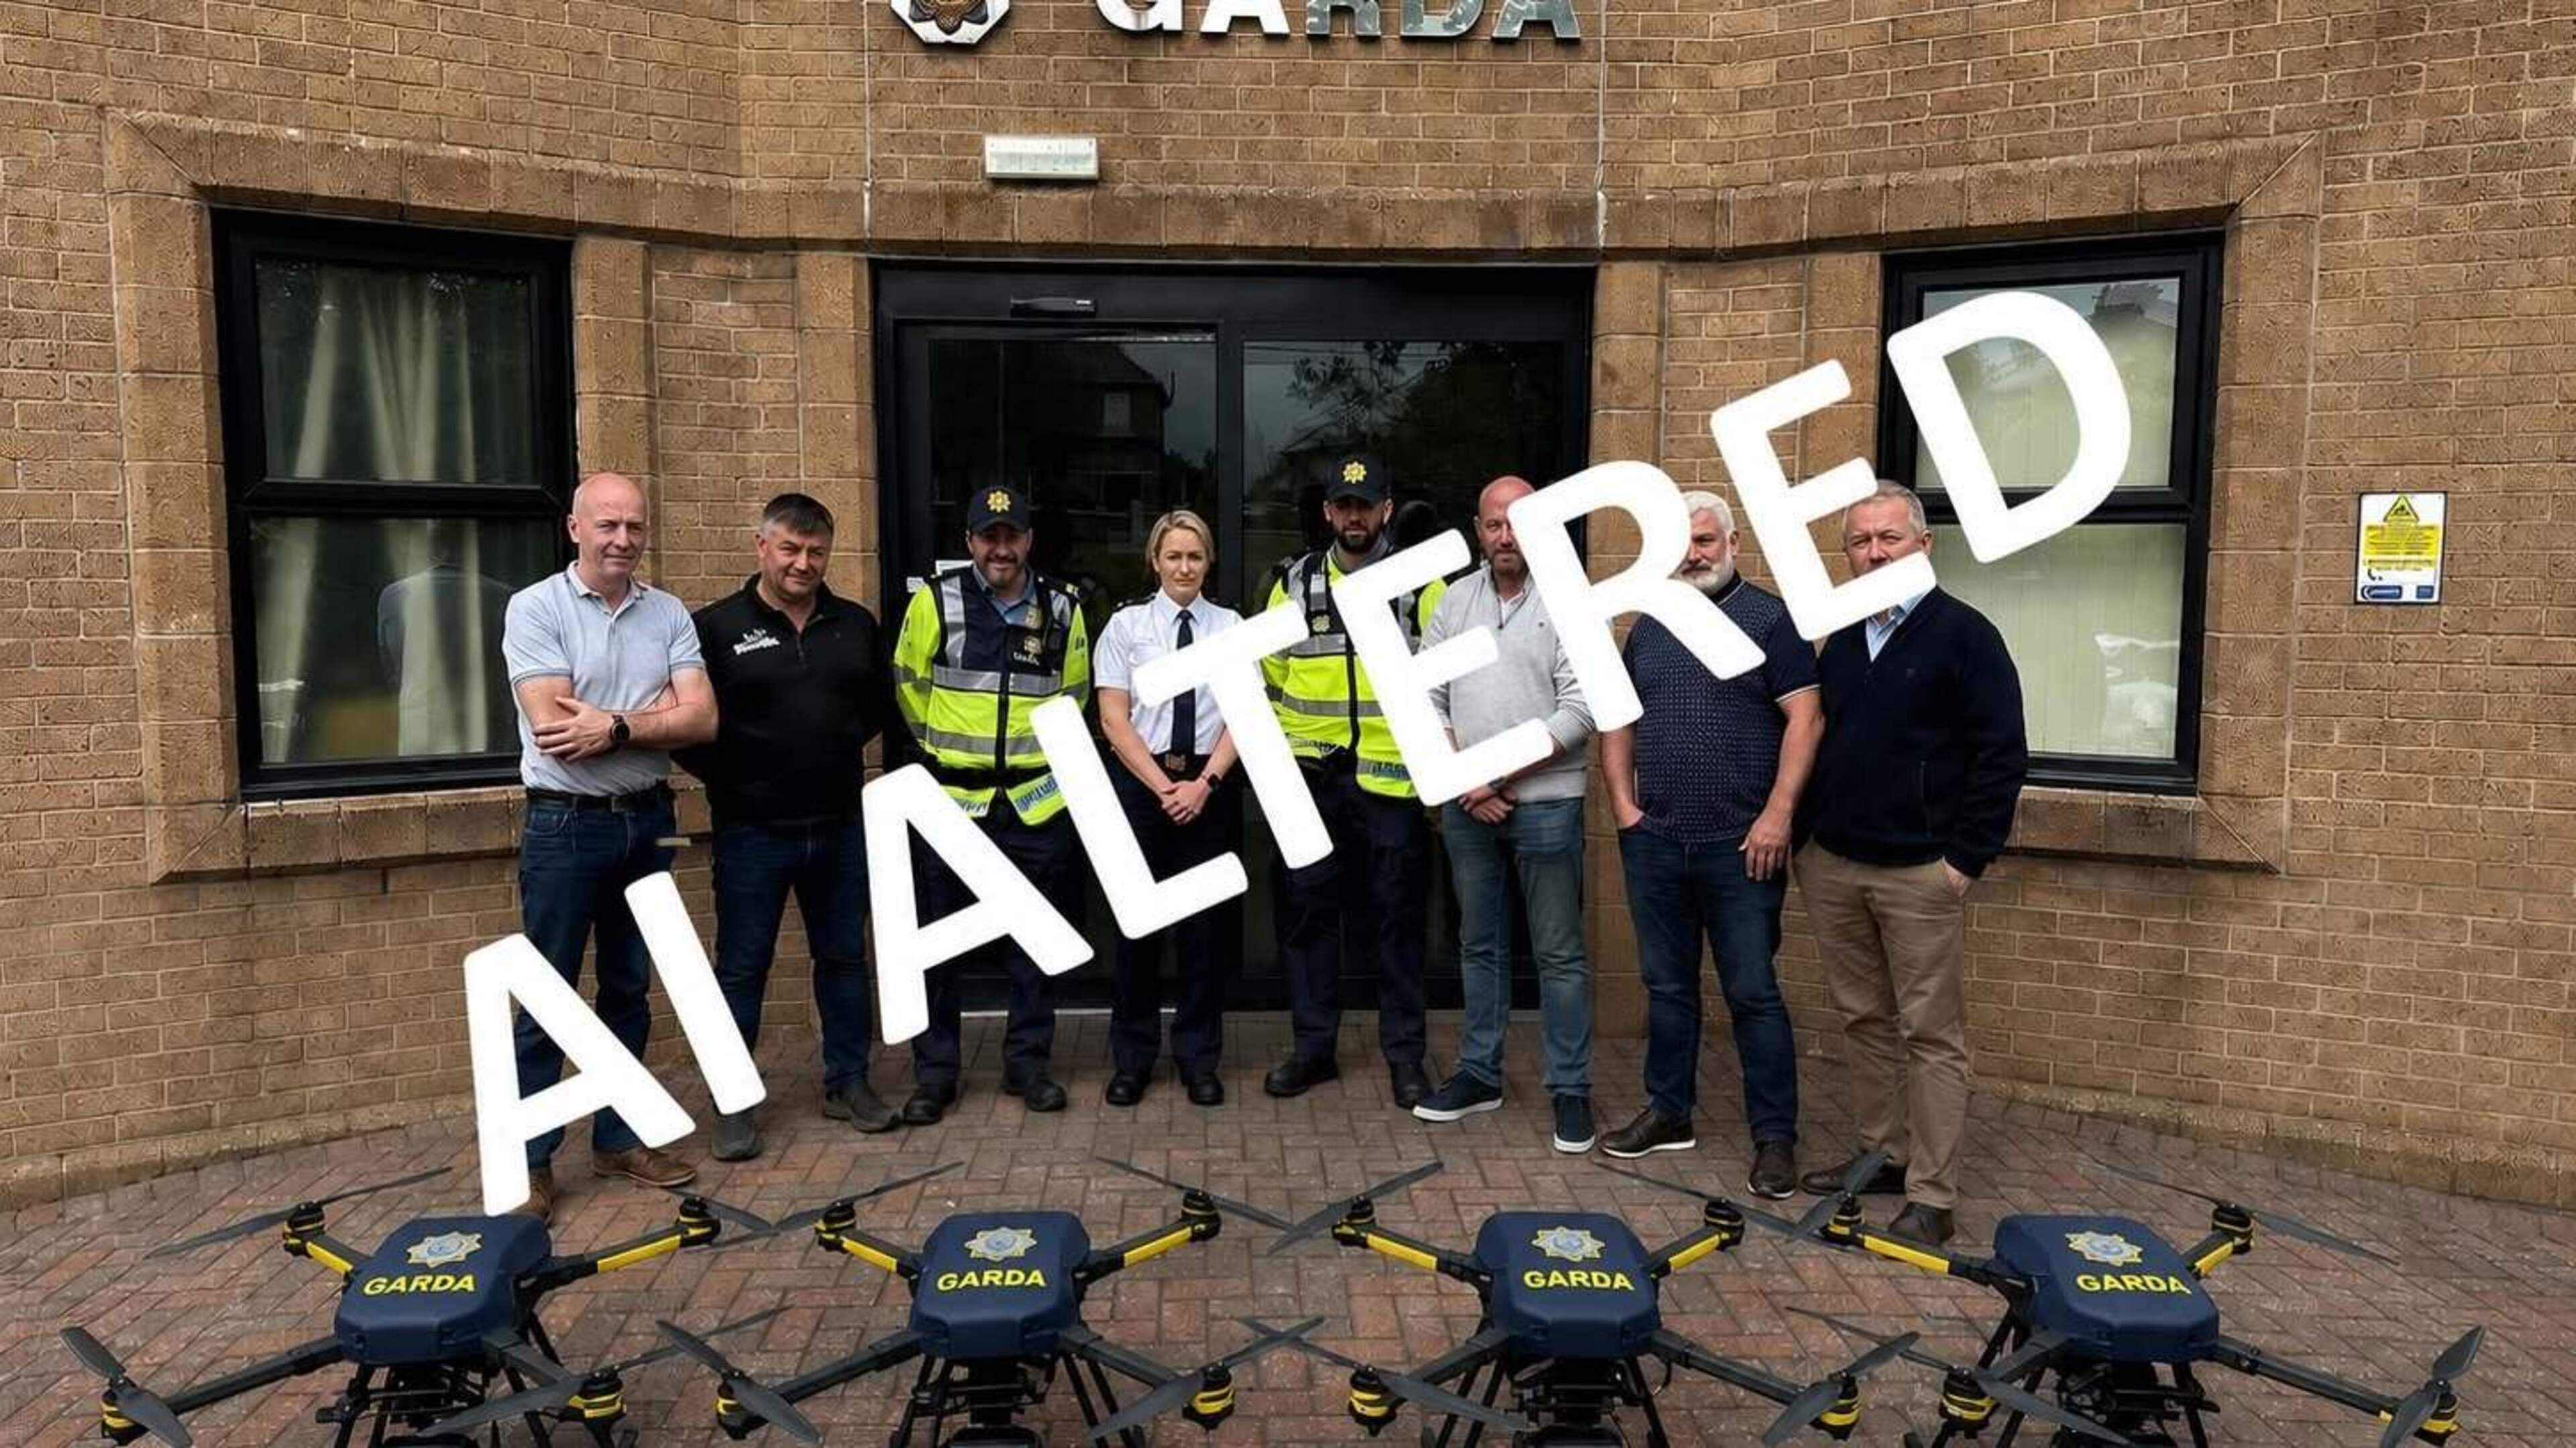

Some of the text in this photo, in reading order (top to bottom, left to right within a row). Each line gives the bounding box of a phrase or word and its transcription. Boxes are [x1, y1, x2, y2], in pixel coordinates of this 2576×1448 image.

[363, 1274, 476, 1295] GARDA
[936, 1269, 1046, 1291] GARDA
[1523, 1270, 1635, 1291] GARDA
[2076, 1274, 2192, 1295] GARDA
